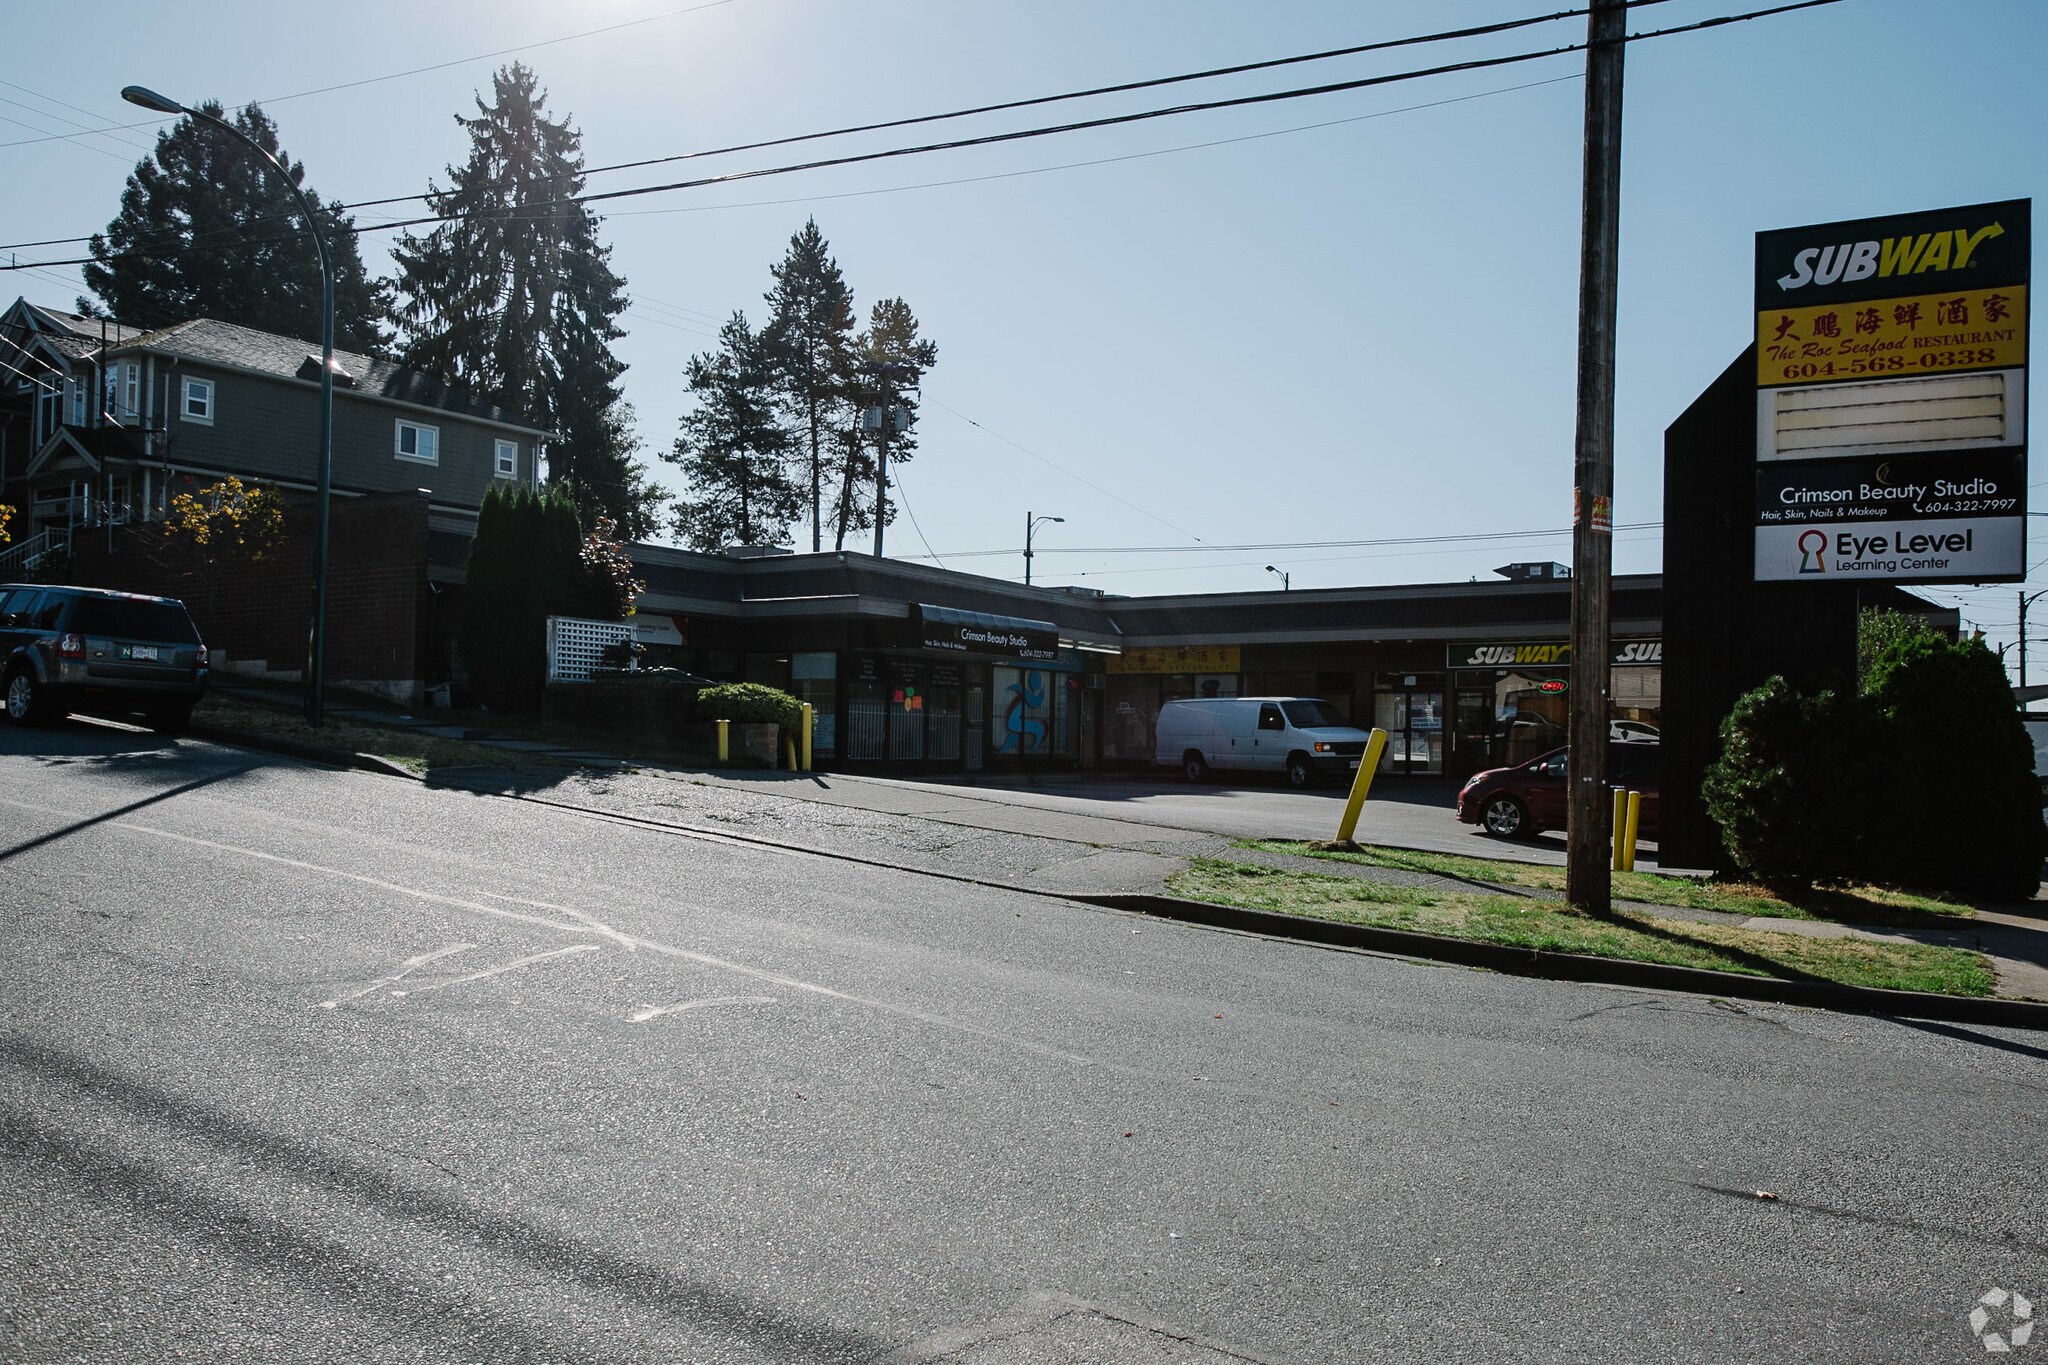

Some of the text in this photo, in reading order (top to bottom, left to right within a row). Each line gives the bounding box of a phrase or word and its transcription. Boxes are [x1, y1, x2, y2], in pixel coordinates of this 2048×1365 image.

[1777, 221, 2005, 292] SUBWAY
[1772, 294, 2011, 342] 大鵬海鮮酒家
[1766, 329, 2015, 363] The Roc Seafood RESTAURANT
[1783, 349, 1996, 379] 604-568-0338
[1780, 478, 1997, 504] Crimson Beauty Studio
[1761, 507, 1887, 521] Hair, Skin, Nails & Makeup
[1925, 499, 2016, 513] 604-322-7997
[1836, 529, 1972, 560] Eye Level
[1836, 557, 1950, 572] Learning Center
[961, 628, 1028, 647] Crimson Beauty Studio
[1467, 644, 1572, 665] SUBWAY
[1541, 681, 1565, 690] OPEN
